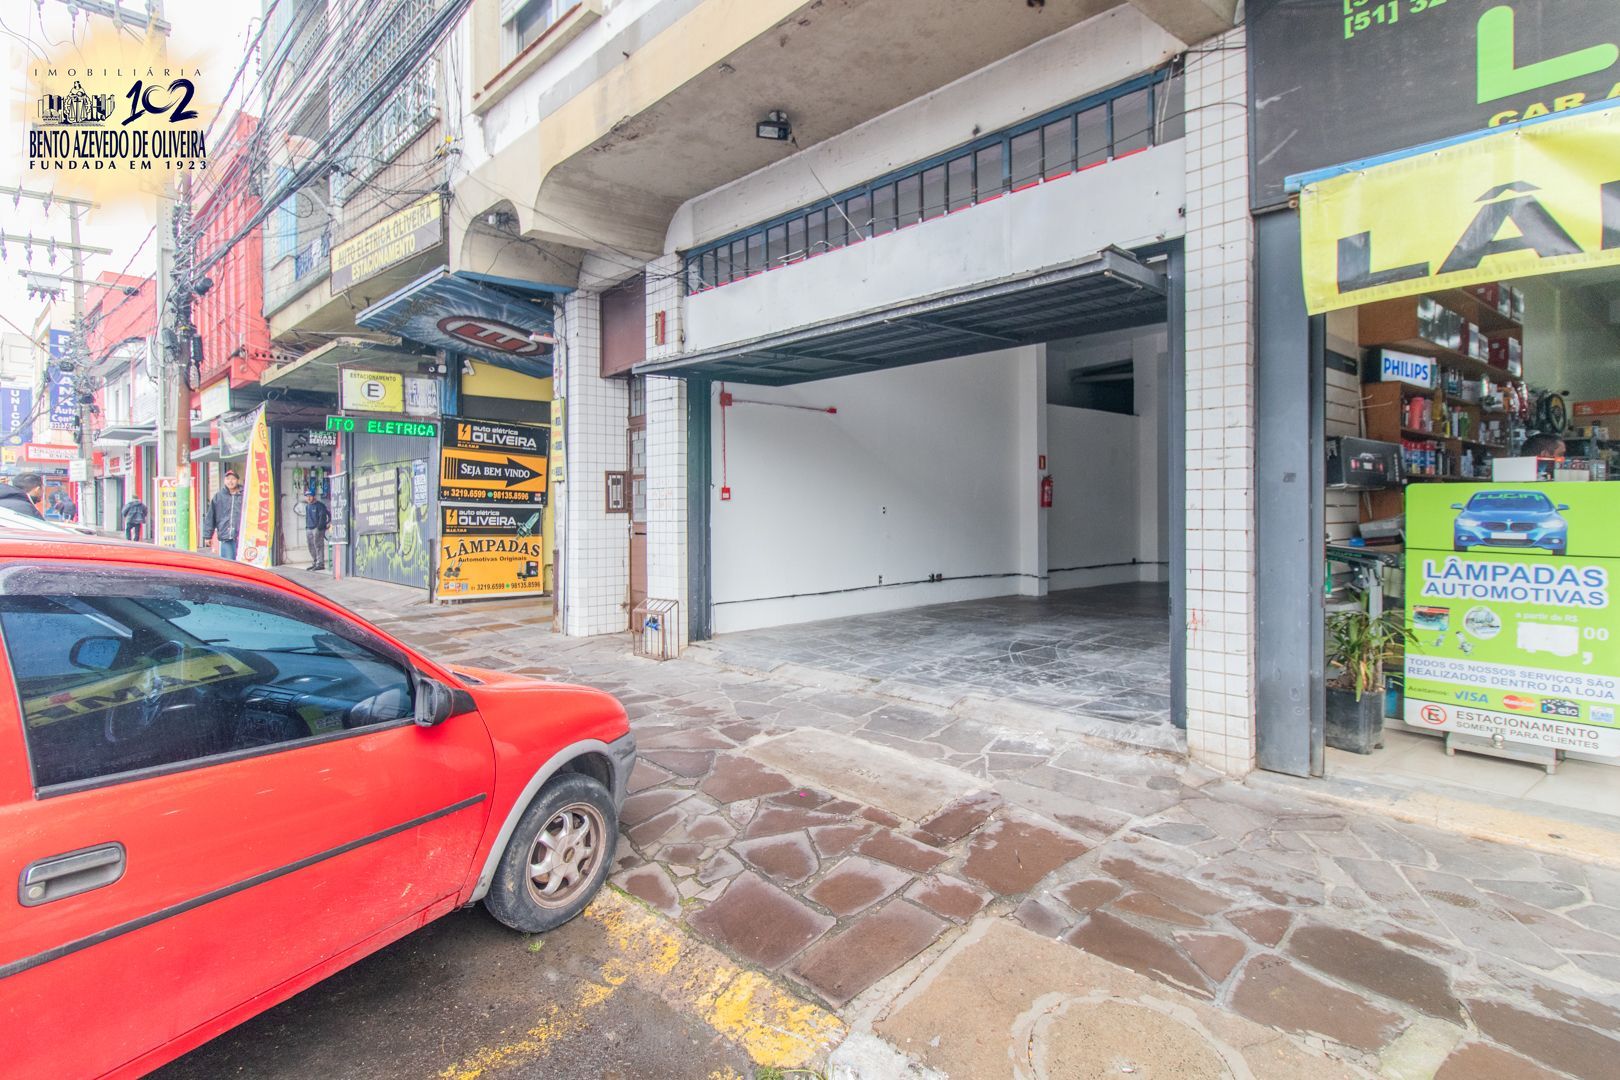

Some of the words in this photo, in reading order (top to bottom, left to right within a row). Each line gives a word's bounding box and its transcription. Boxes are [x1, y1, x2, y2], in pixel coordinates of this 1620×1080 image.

[393, 203, 432, 239] OLIVEIRA
[1336, 180, 1620, 295] LÂ
[351, 234, 417, 281] ESTACIONAMENTO
[349, 371, 397, 383] ESTACIONAMENTO
[1383, 356, 1430, 382] PHILIPS
[366, 382, 380, 399] E
[367, 421, 435, 437] ELETRICA
[472, 425, 491, 433] auto
[472, 432, 537, 448] OLIVEIRA
[483, 466, 502, 477] BEM
[504, 468, 531, 479] VINDO
[254, 452, 271, 548] LAVAGEM
[450, 488, 487, 499] 3219.6599
[458, 515, 518, 527] OLIVEIRA
[443, 538, 541, 560] LÂMPADAS
[499, 555, 527, 563] Originais
[1425, 558, 1605, 589] LÂMPADAS
[476, 583, 506, 591] 3219.6599
[1424, 581, 1606, 607] AUTOMOTIVAS
[1409, 657, 1447, 670] TODOS
[1449, 662, 1467, 672] OS
[1468, 664, 1516, 678] NOSSOS
[1519, 669, 1583, 686] SERVIÇOS
[1407, 666, 1488, 684] REALIZADOS
[1490, 676, 1548, 692] DENTRO
[1551, 683, 1573, 694] DA
[1576, 686, 1616, 700] LOJA
[1455, 689, 1489, 704] VISA
[1456, 710, 1600, 741] ESTACIONAMENTO
[1456, 720, 1507, 737] SOMENTE
[1509, 729, 1540, 741] PARA
[1542, 734, 1601, 750] CLIENTES
